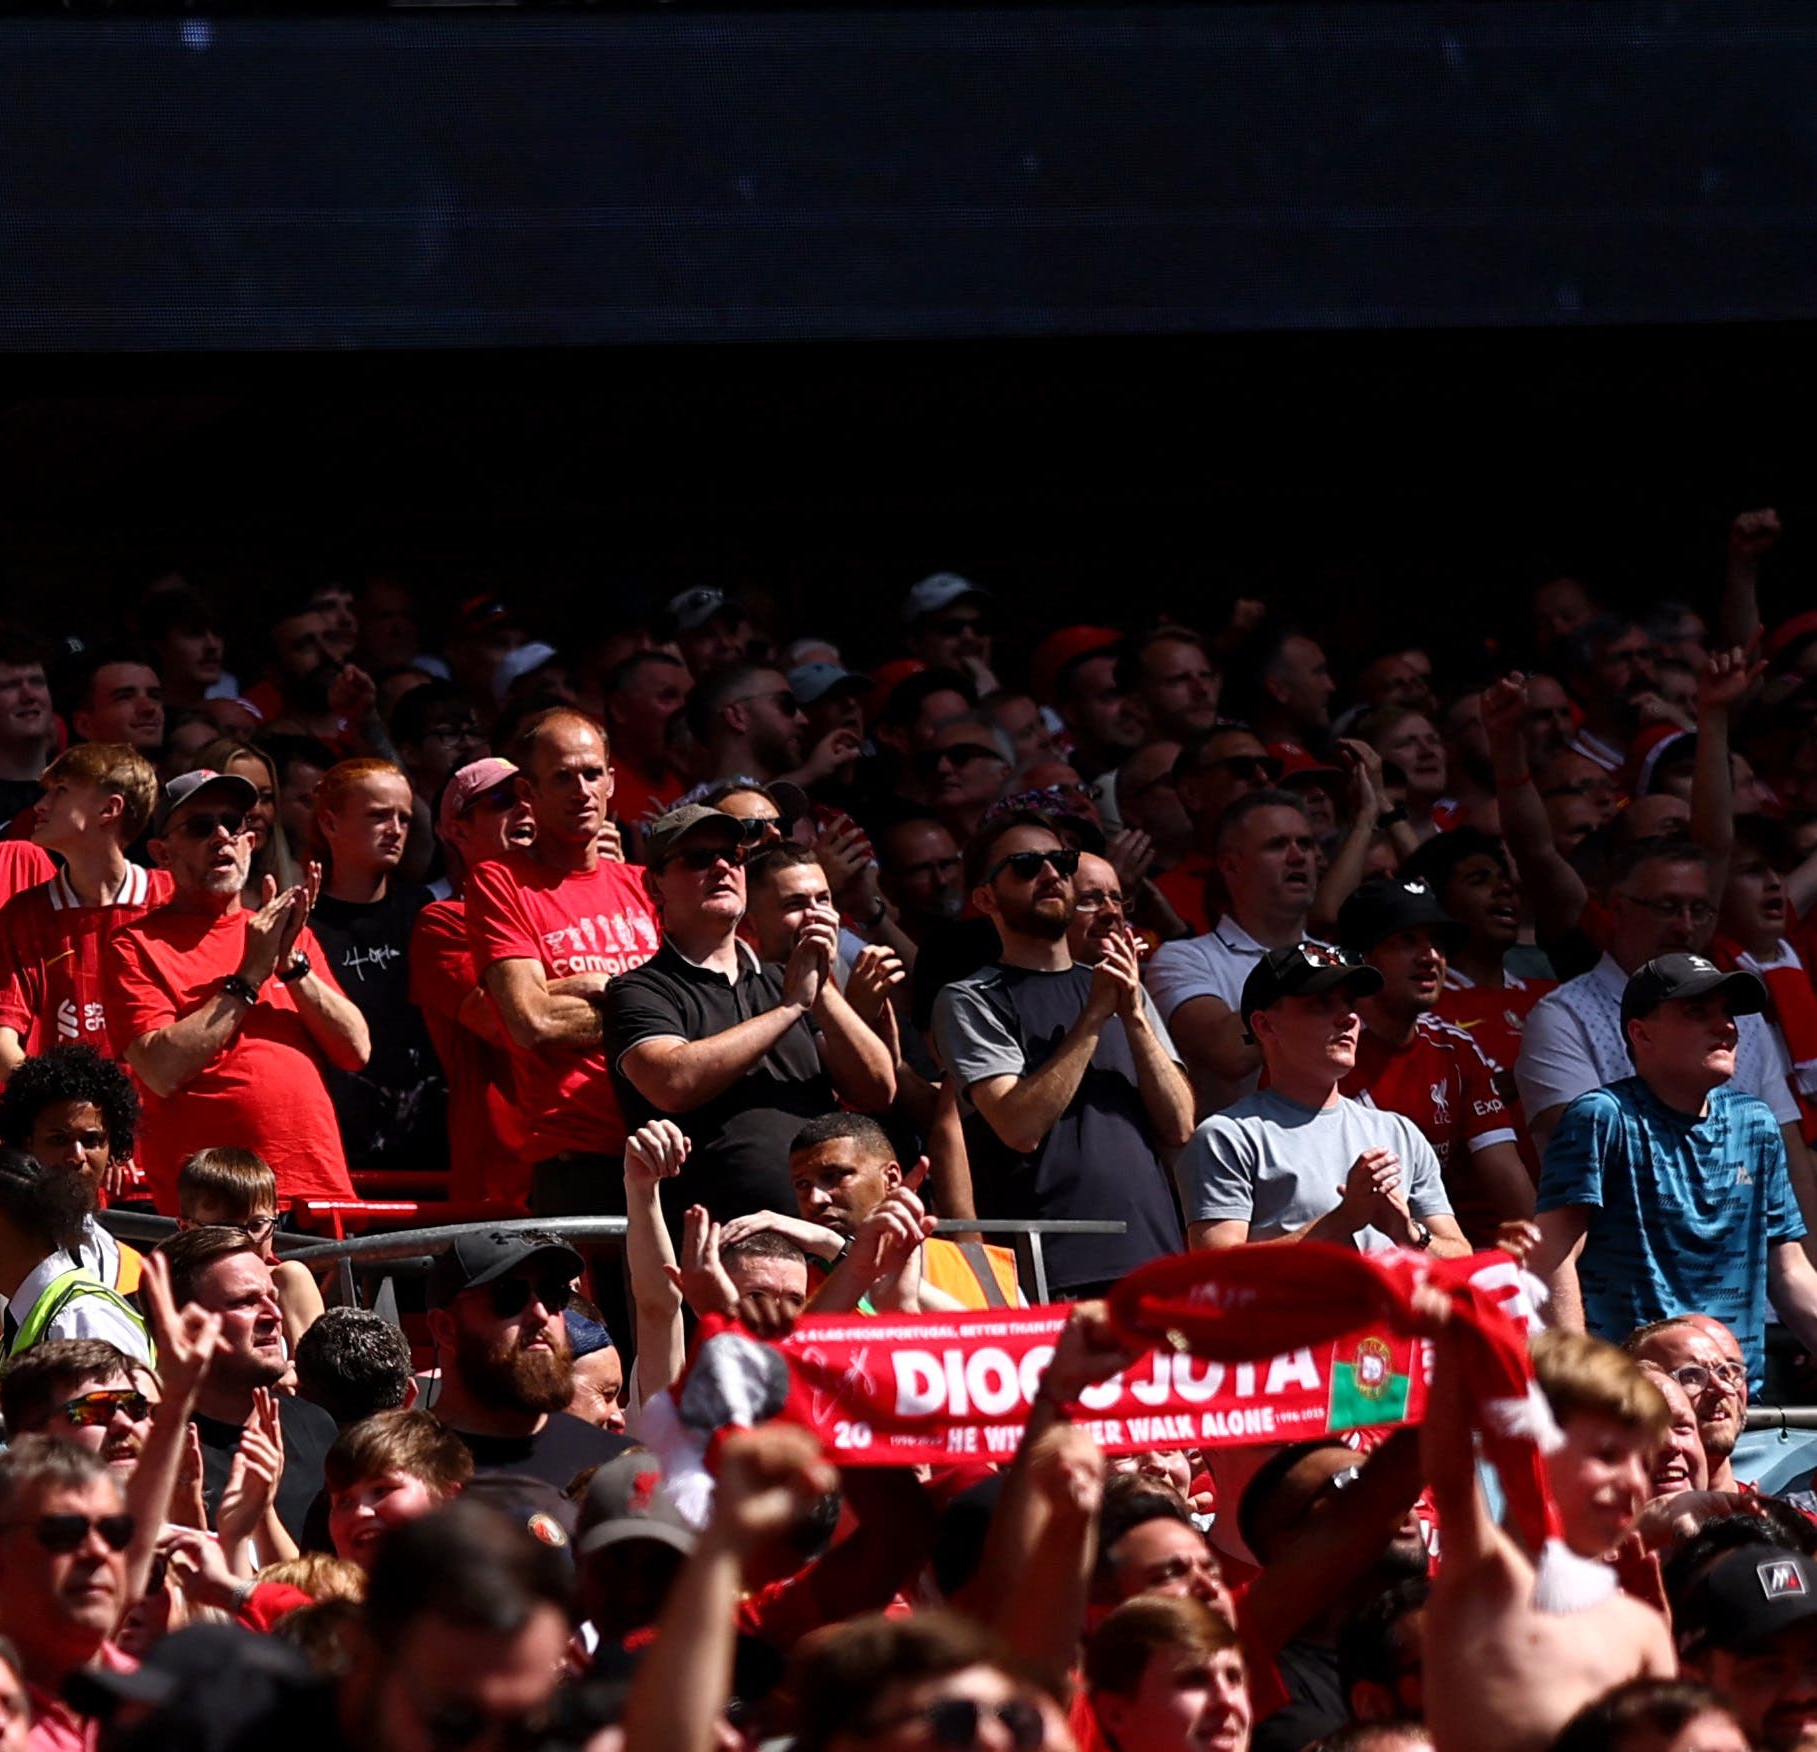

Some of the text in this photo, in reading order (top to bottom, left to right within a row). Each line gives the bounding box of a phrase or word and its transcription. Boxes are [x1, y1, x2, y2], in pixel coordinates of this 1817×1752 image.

[833, 1420, 873, 1449] 20
[946, 1426, 978, 1454] HE
[1126, 1414, 1197, 1444] WALK
[1201, 1406, 1276, 1437] ALONE
